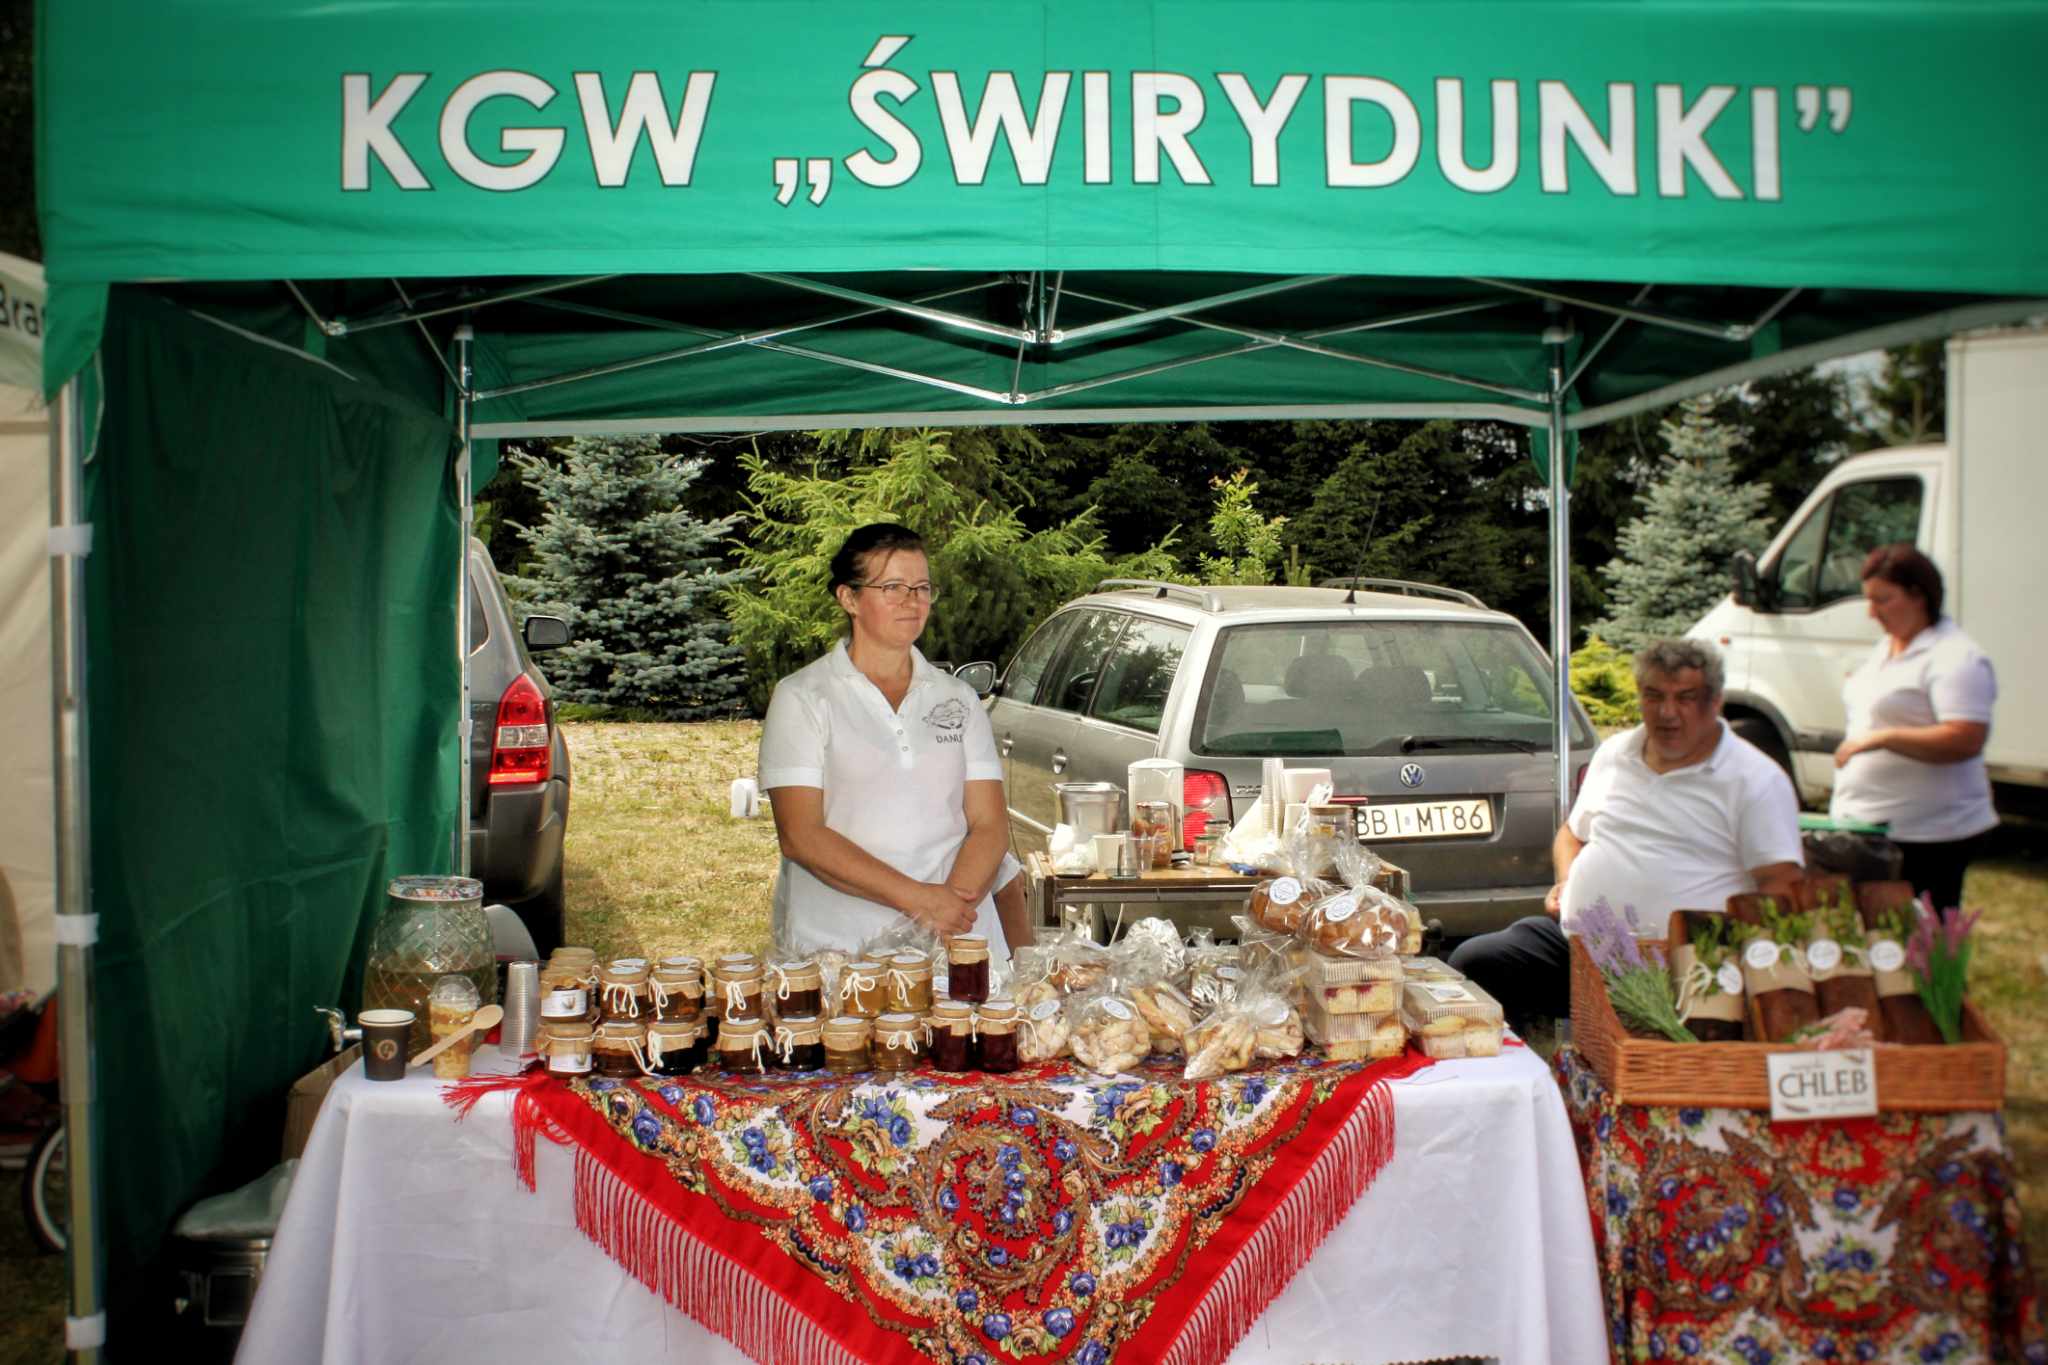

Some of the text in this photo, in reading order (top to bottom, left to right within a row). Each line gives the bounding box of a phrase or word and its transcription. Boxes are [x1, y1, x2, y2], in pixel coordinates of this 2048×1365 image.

[340, 69, 718, 192] KGW
[1416, 804, 1484, 833] MT86
[1777, 1069, 1868, 1098] CHLEB
